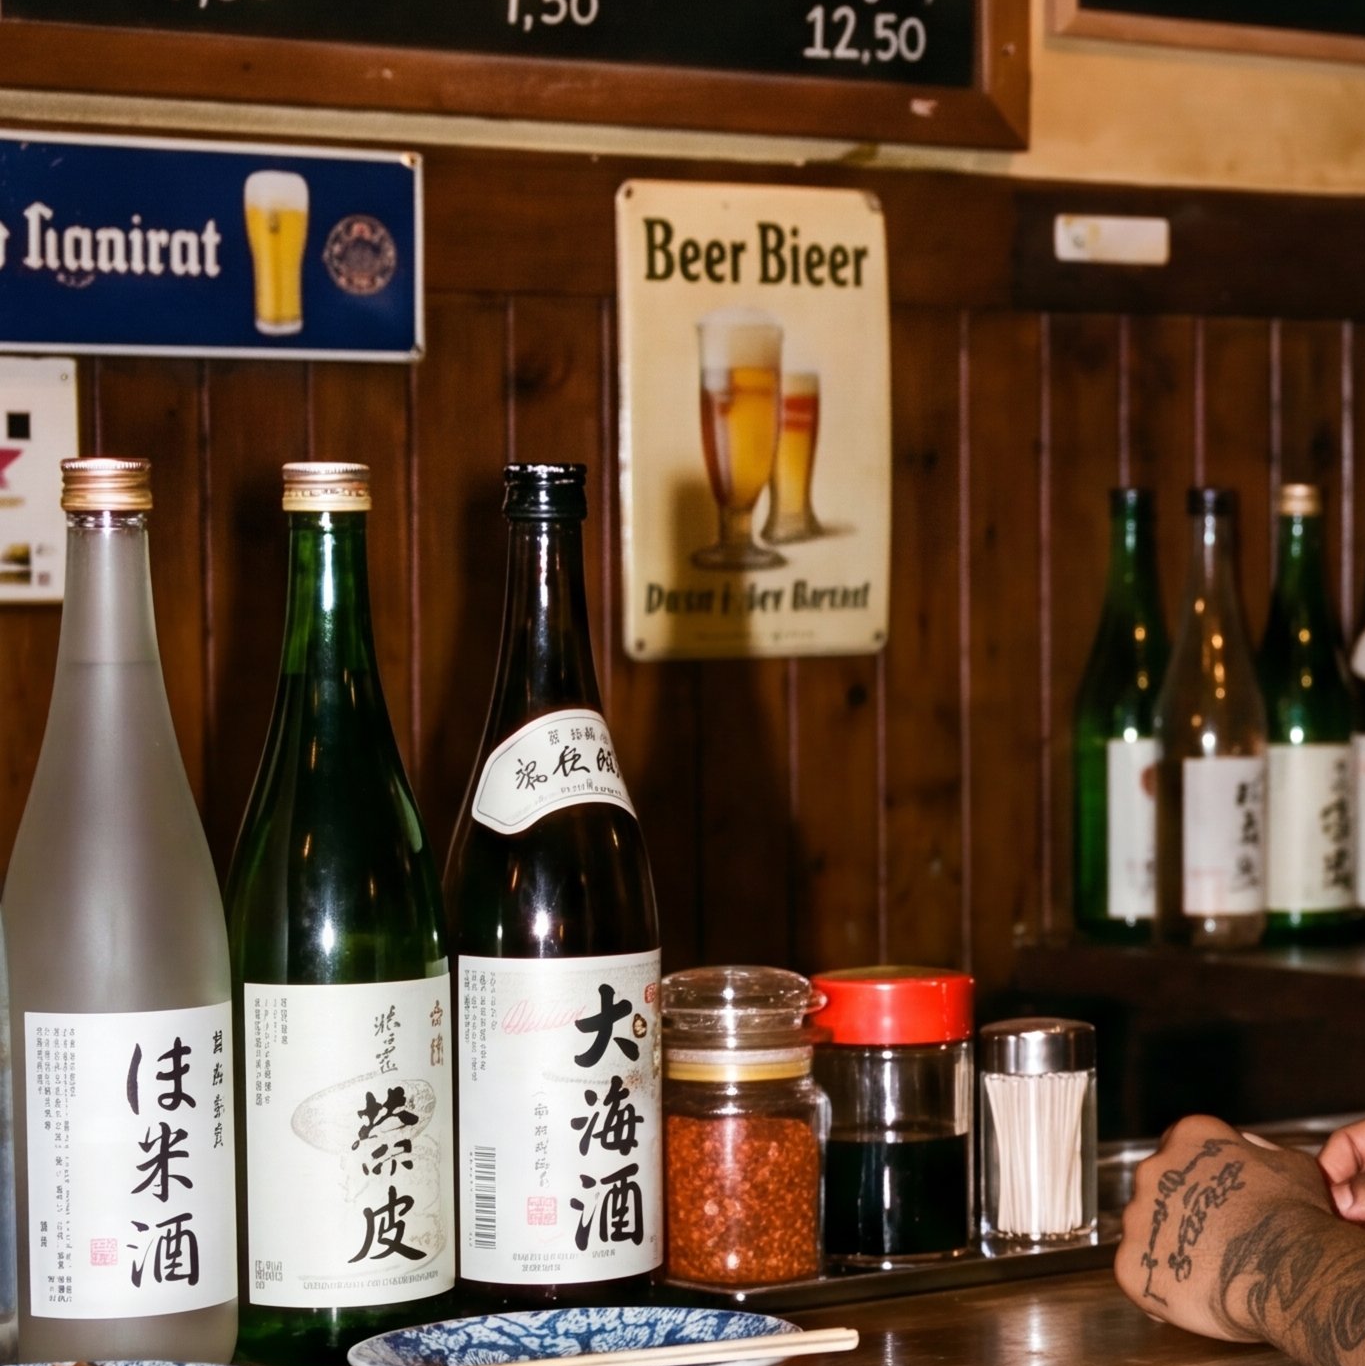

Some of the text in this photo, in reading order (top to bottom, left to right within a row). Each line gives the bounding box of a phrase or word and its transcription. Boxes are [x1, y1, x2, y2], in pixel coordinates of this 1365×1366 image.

[802, 3, 928, 66] 12,50
[643, 216, 869, 289] Beer Bieer
[570, 982, 645, 1252] 大海酒
